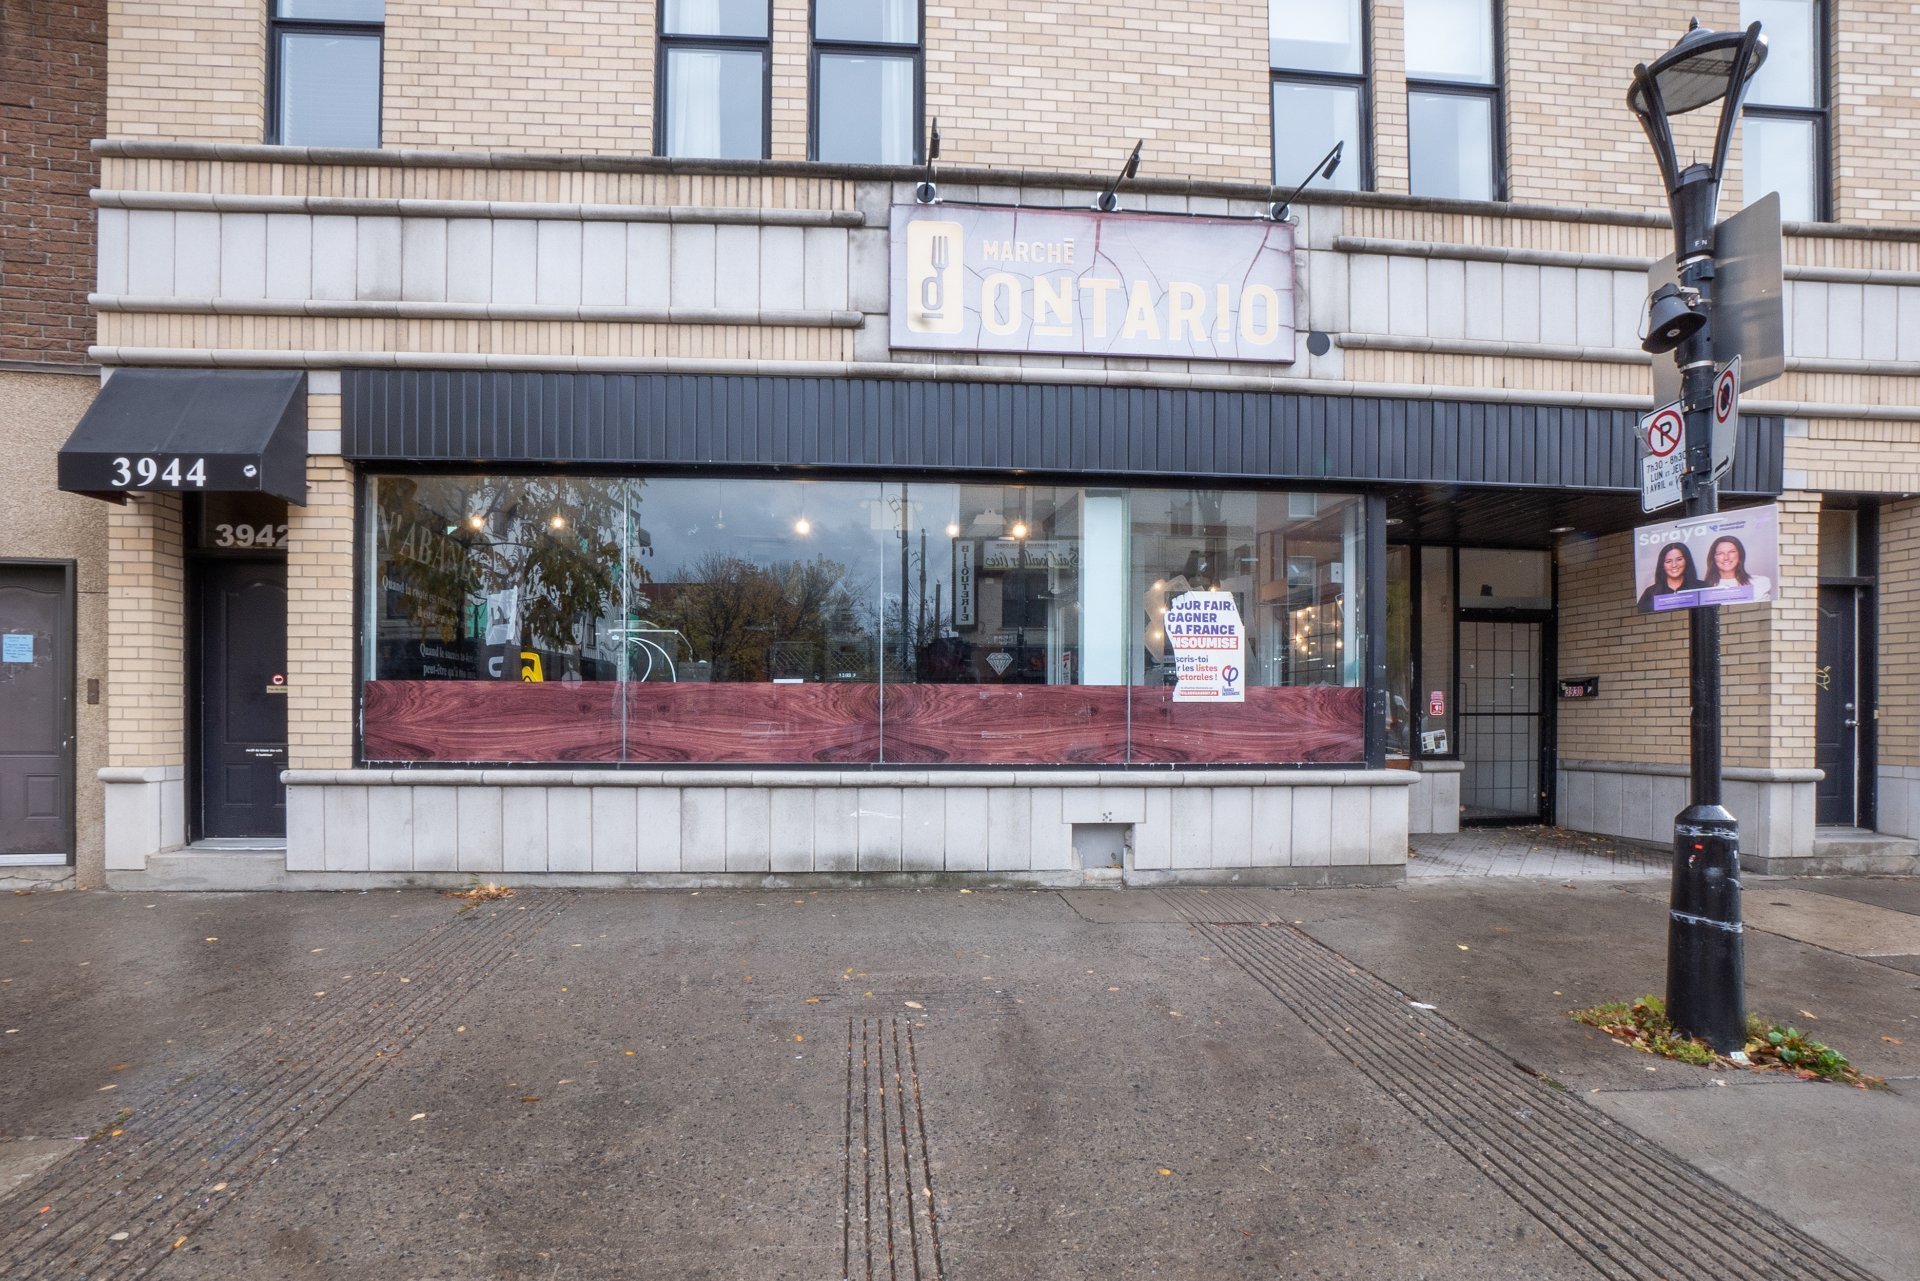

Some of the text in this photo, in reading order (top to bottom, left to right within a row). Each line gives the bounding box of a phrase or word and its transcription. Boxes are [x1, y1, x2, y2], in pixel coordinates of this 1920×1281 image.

[111, 456, 207, 487] 3944
[1646, 460, 1663, 474] 7h30
[1650, 470, 1663, 483] LUN
[1650, 480, 1666, 493] AVRIL
[215, 523, 288, 547] 3942
[1639, 525, 1707, 546] Soraya
[1203, 600, 1236, 611] FAIR
[1167, 612, 1218, 623] GAGNER
[1186, 624, 1235, 635] FRANCE
[1173, 637, 1238, 649] NSOUMISE
[1182, 664, 1195, 672] les
[1196, 663, 1218, 672] listes
